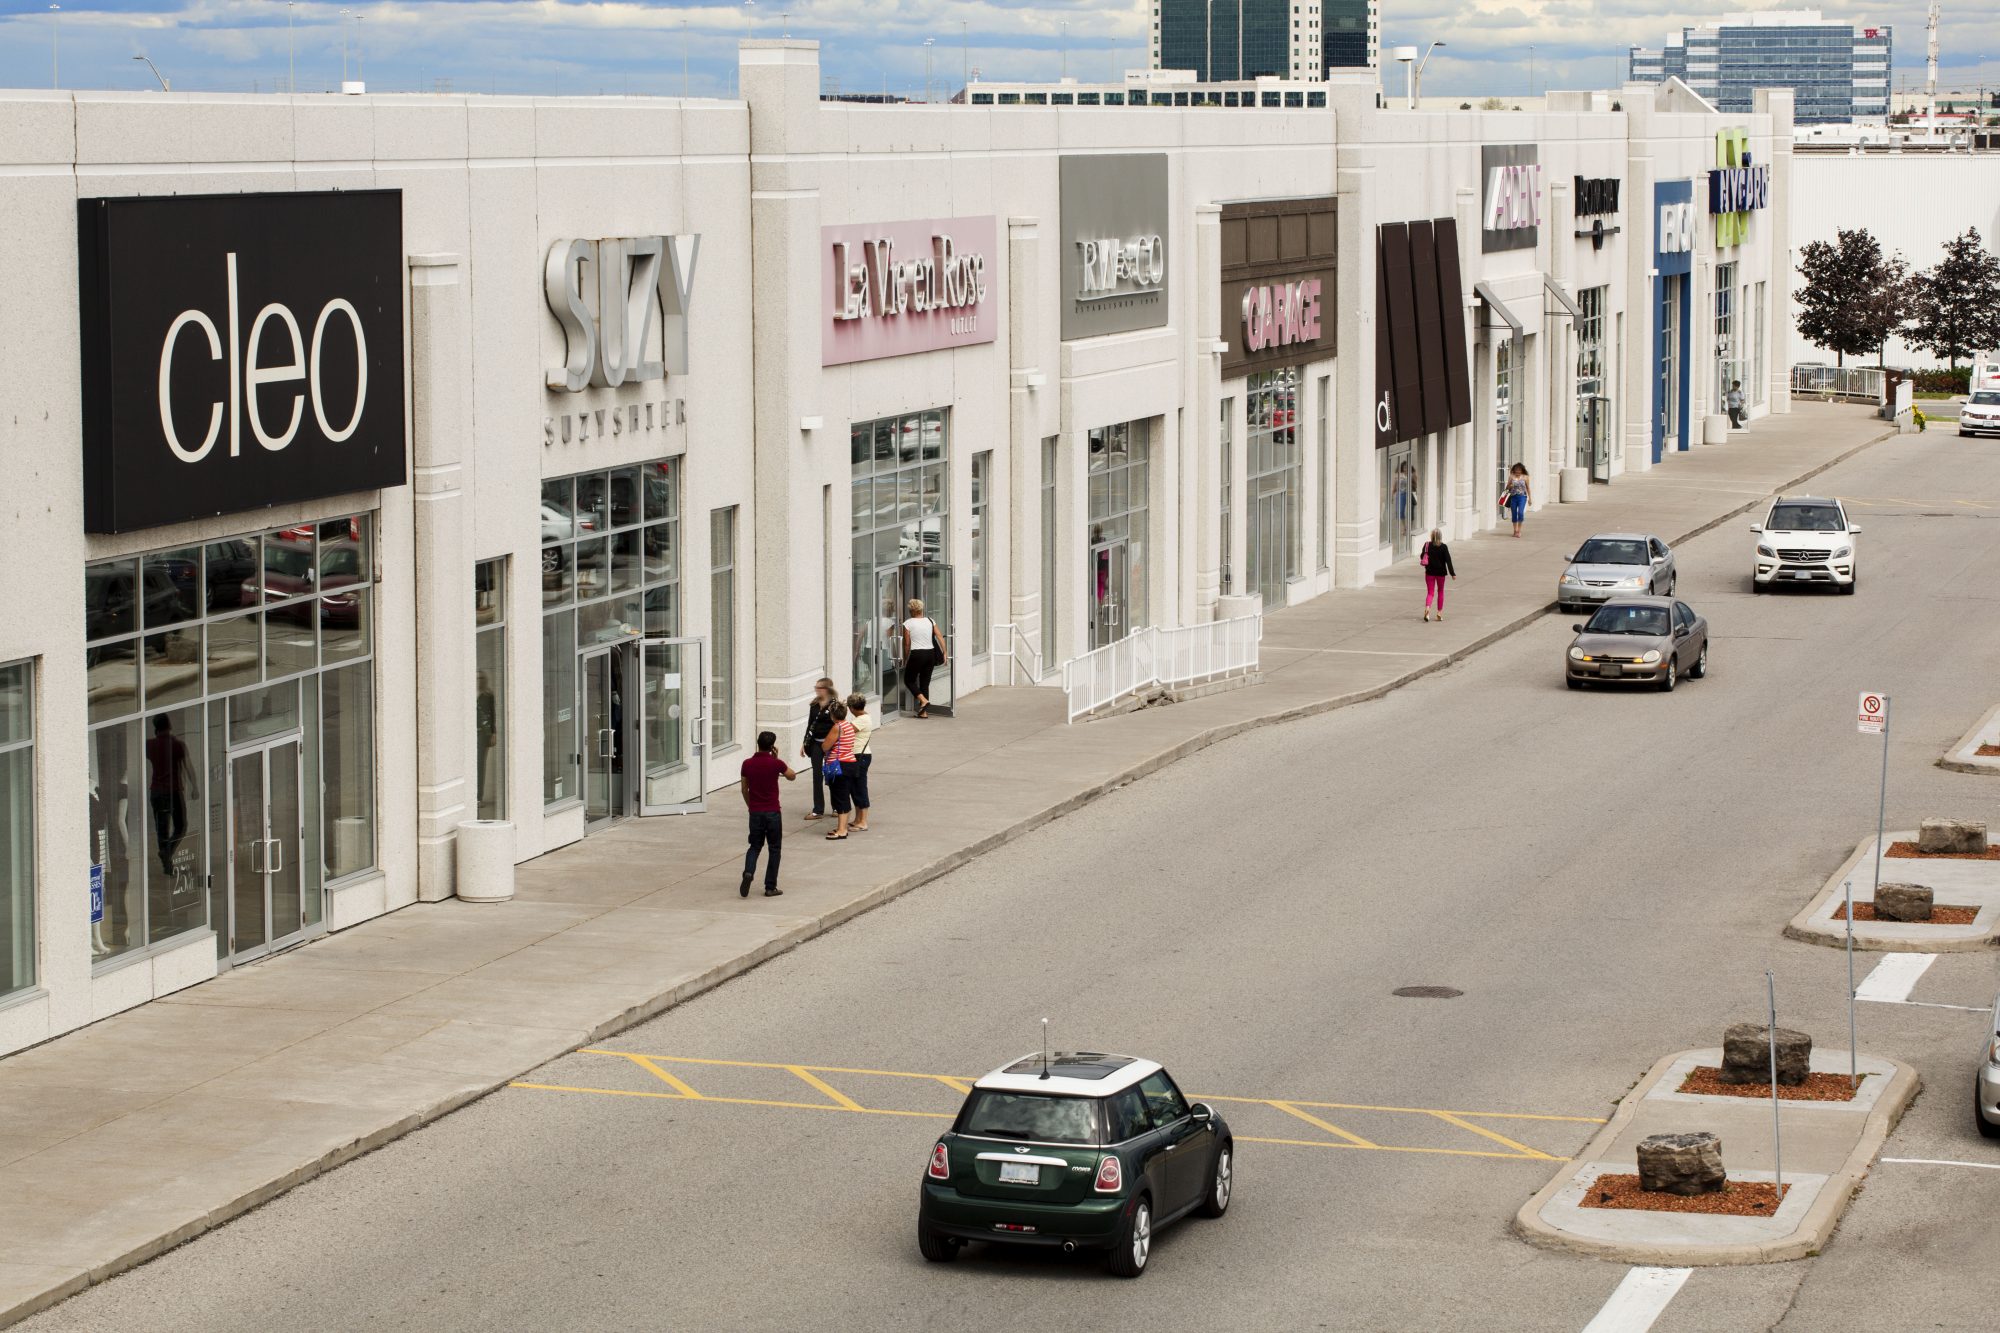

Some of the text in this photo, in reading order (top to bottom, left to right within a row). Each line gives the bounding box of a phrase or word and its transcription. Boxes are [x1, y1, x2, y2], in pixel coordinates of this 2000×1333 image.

[1483, 165, 1541, 231] ARDENE
[833, 233, 986, 320] La Vie en Rose
[544, 235, 701, 393] SUZY
[951, 315, 977, 336] OUTLET
[1241, 279, 1321, 352] GARAGE
[159, 252, 368, 463] cleo
[544, 398, 687, 447] SUZYSHIER
